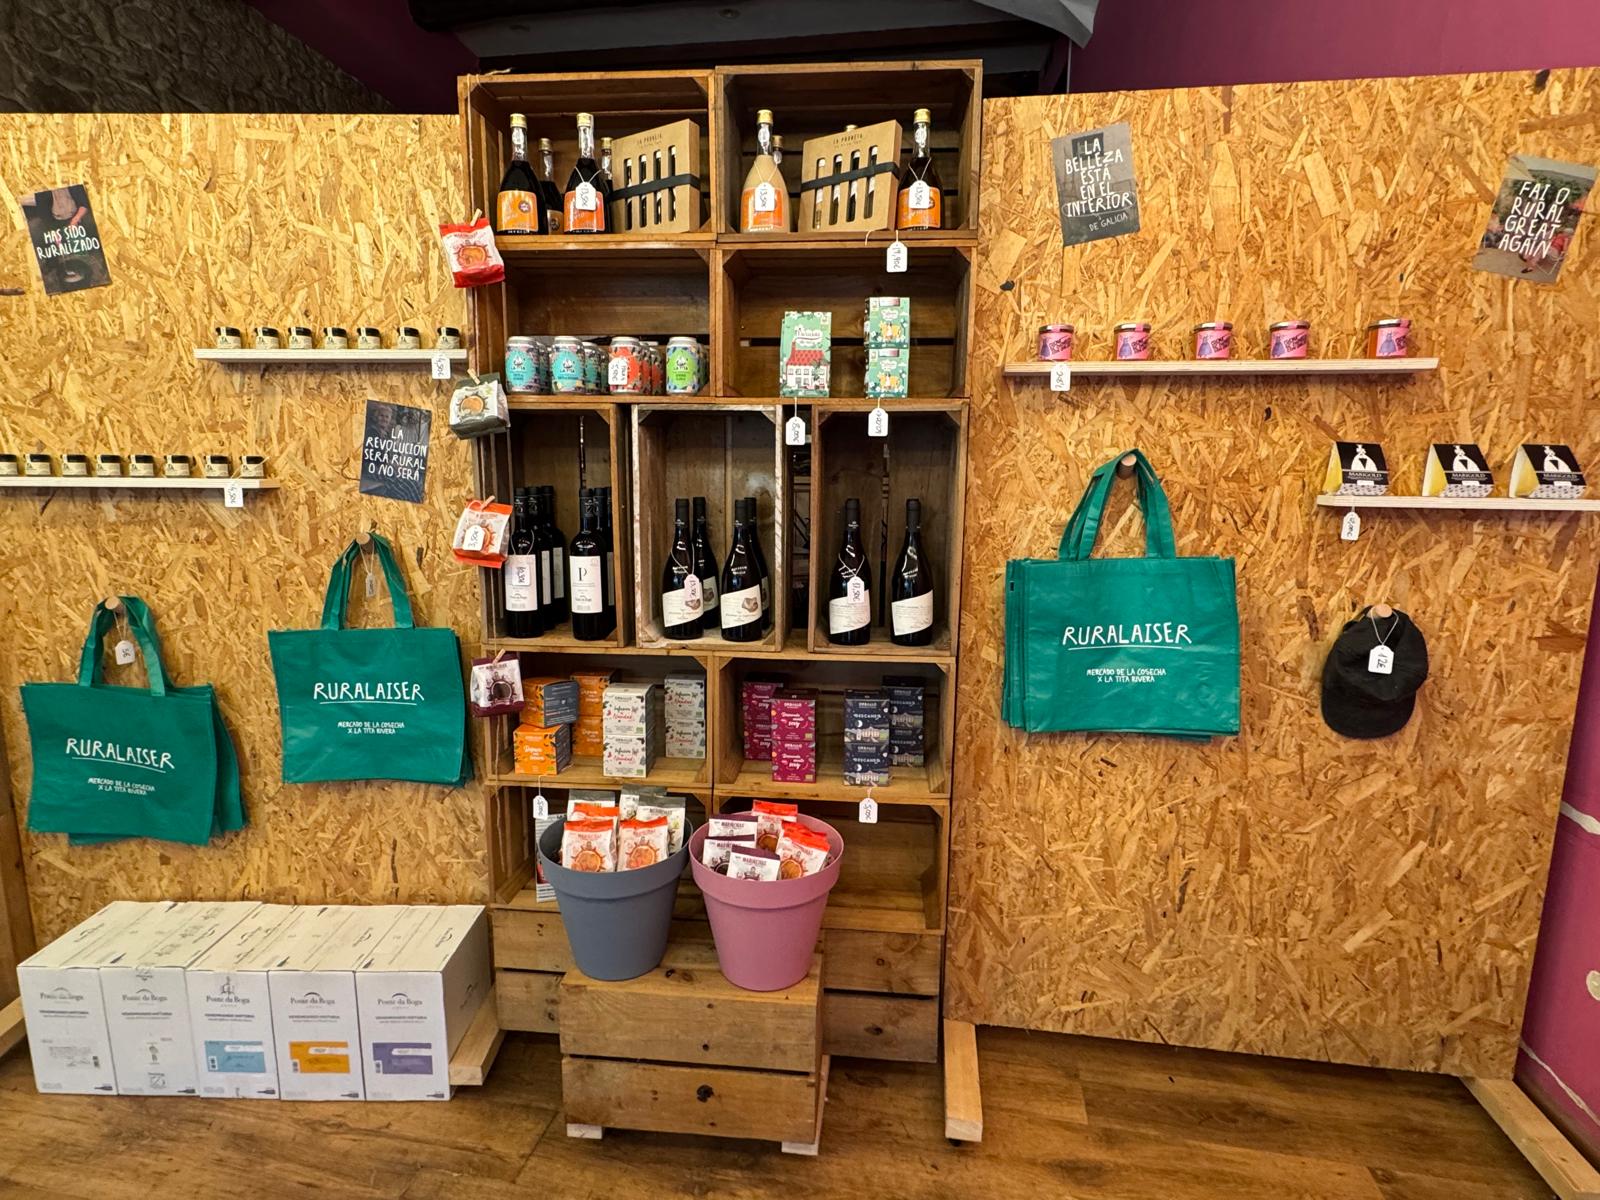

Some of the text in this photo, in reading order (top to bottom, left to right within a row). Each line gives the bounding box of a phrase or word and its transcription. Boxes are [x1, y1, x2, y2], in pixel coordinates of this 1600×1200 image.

[1084, 138, 1101, 155] LA
[1065, 149, 1123, 175] BELLEZA
[1080, 164, 1111, 185] ESTÁ
[1080, 181, 1114, 201] EN EL
[1519, 181, 1571, 205] FAI O
[1066, 192, 1133, 217] INTERIOR
[1511, 197, 1564, 223] RURAL
[1088, 212, 1128, 231] DE GALICIA
[1504, 215, 1561, 241] GREAT
[43, 225, 86, 244] HAS SIDO
[36, 237, 100, 260] RURALIZADO
[1498, 233, 1552, 259] AGAIN
[391, 428, 404, 440] LA
[365, 436, 427, 457] REVOLUCIÓN
[364, 448, 425, 470] SERÁ RURAL
[368, 462, 419, 481] O NO SERÁ
[1348, 471, 1382, 479] MARIGOLD
[578, 567, 588, 582] P
[1062, 621, 1192, 646] RURALAISER
[1376, 652, 1388, 669] 12€
[1086, 668, 1115, 676] MERCADO
[1116, 668, 1125, 676] DE
[1137, 668, 1167, 676] COSECHA
[1131, 675, 1155, 683] RIVERA
[313, 682, 425, 701] RURALAISER
[337, 721, 363, 729] MERCADO
[364, 721, 371, 729] DE
[66, 738, 175, 769] RURALAISER
[88, 777, 114, 787] MERCADO
[234, 996, 251, 1004] Boga
[319, 997, 336, 1005] Boga
[406, 998, 423, 1006] Boga
